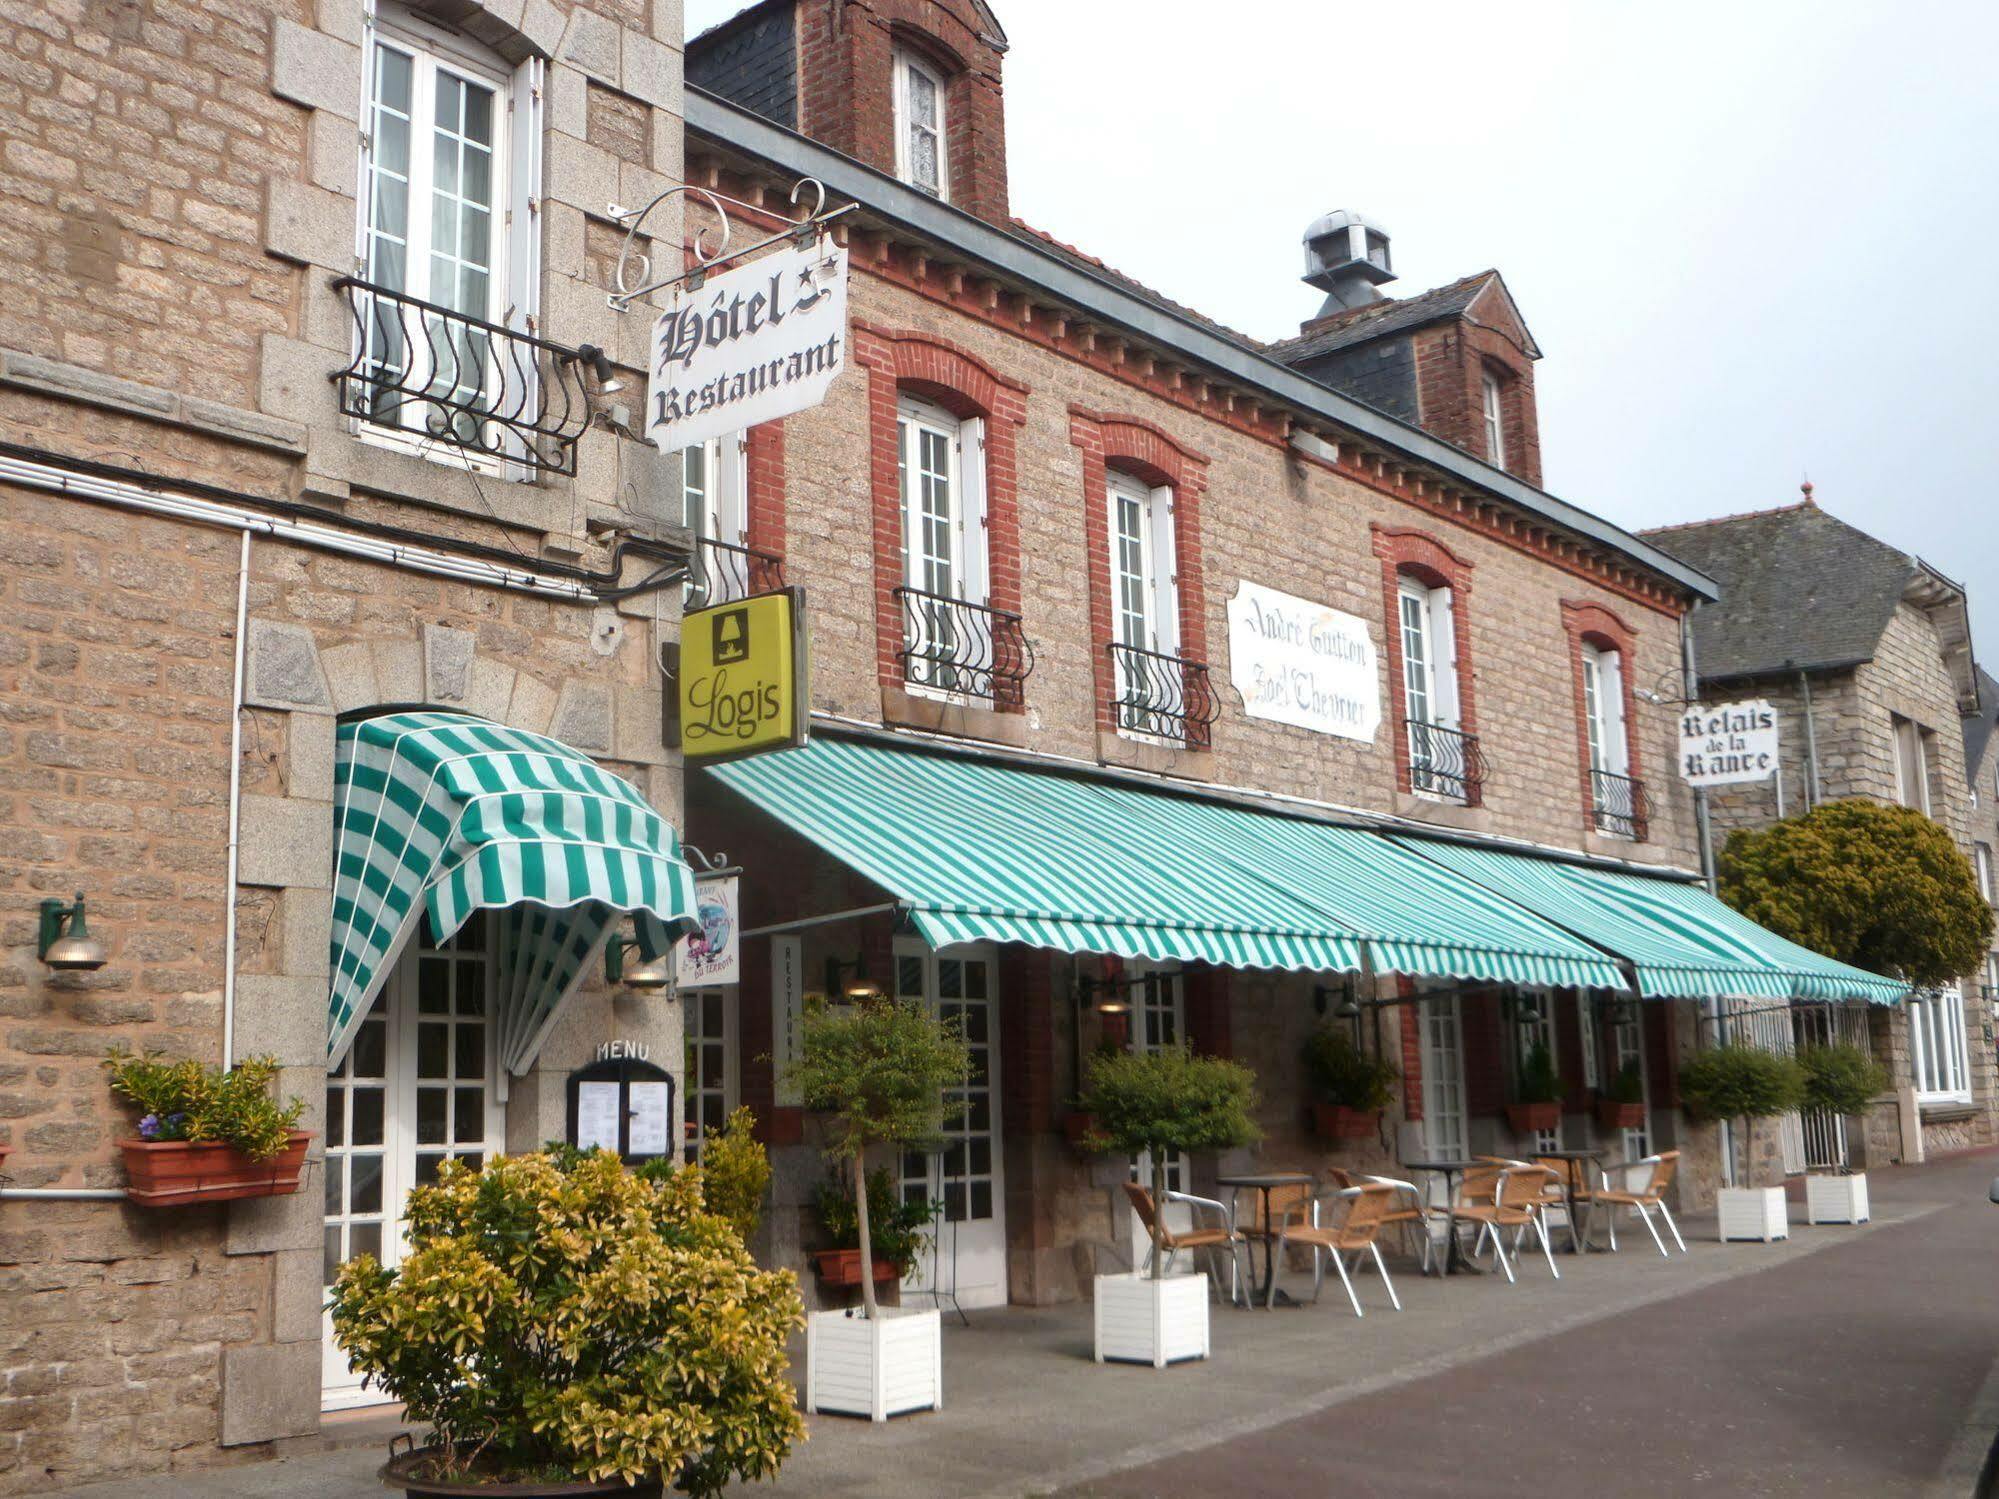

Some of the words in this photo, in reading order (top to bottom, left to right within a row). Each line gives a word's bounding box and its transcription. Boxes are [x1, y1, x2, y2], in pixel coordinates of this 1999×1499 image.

[658, 271, 786, 376] Hôtel
[653, 332, 840, 428] Restaurant
[685, 668, 780, 739] Logis
[1683, 708, 1772, 736] Relais
[1686, 752, 1769, 776] Rance
[1706, 738, 1723, 753] de
[1730, 734, 1745, 751] la
[784, 946, 794, 1070] RESTAURA
[597, 1039, 650, 1062] MENU
